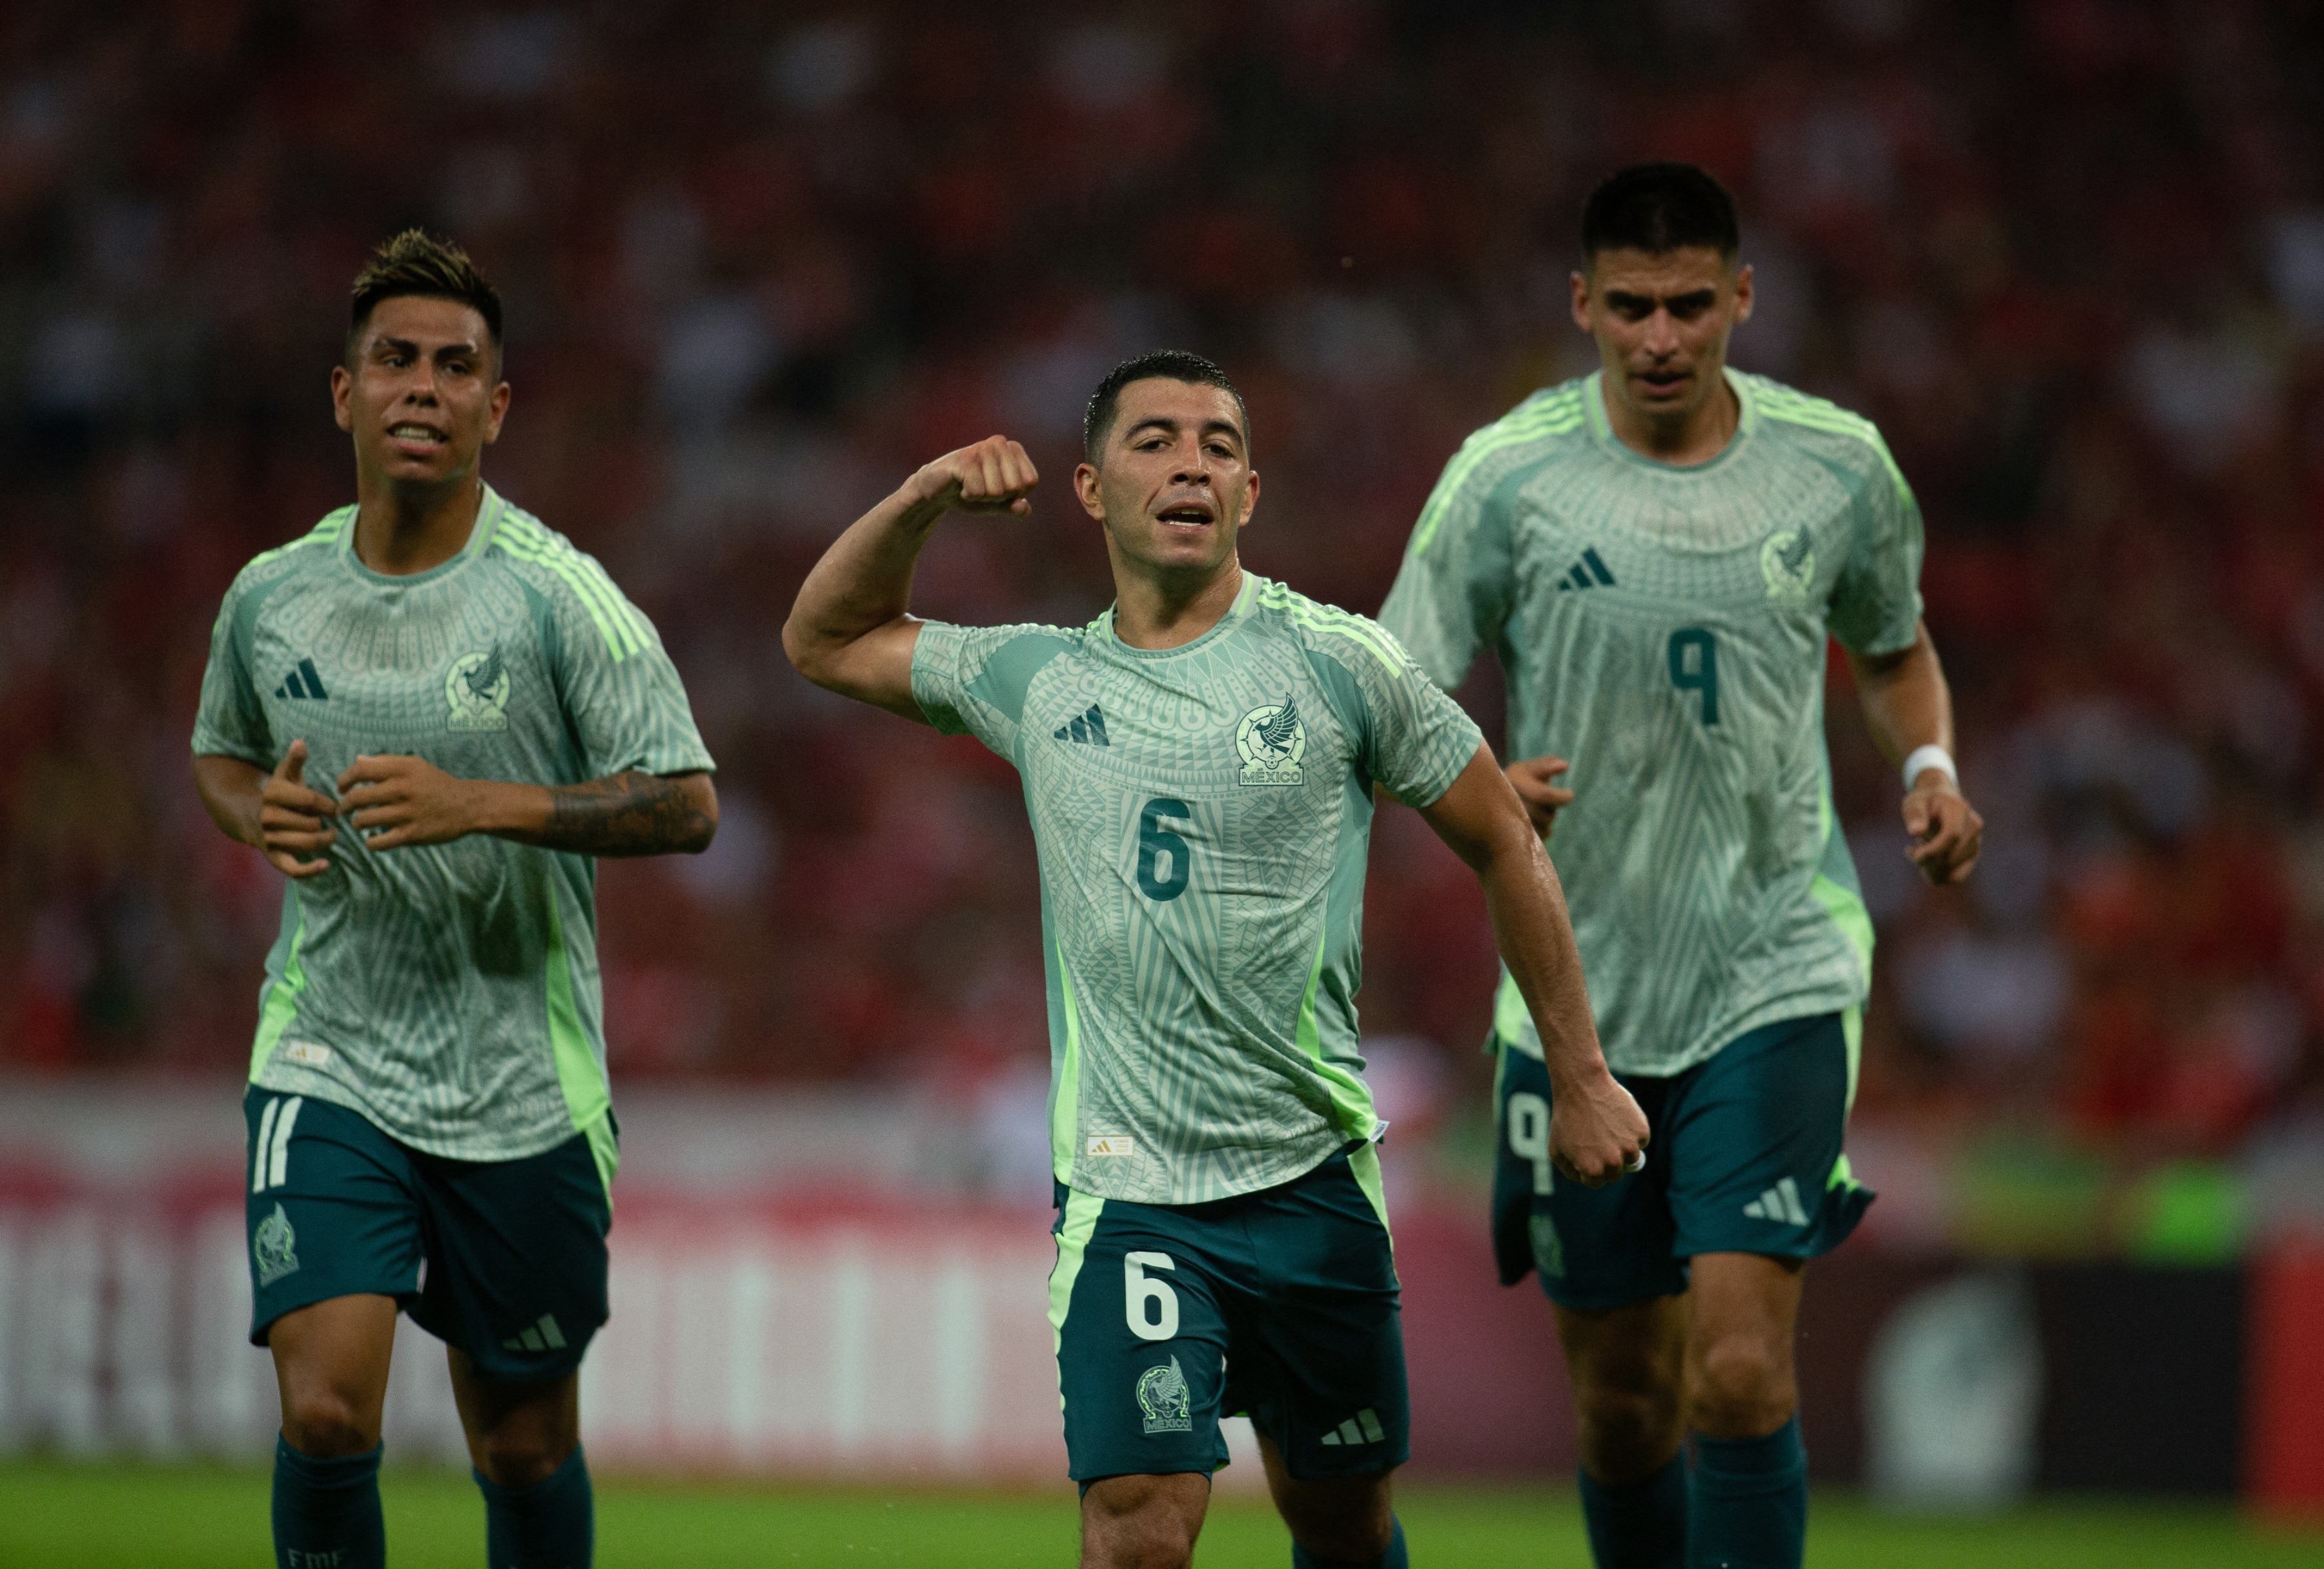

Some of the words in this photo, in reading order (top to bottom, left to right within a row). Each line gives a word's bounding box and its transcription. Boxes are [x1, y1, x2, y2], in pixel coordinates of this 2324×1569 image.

[1669, 629, 1718, 724] 9
[1241, 767, 1301, 783] MÉXICO
[1137, 797, 1190, 902] 6
[252, 1096, 303, 1194] 11
[1507, 1091, 1554, 1195] 9
[1124, 1251, 1179, 1341] 6
